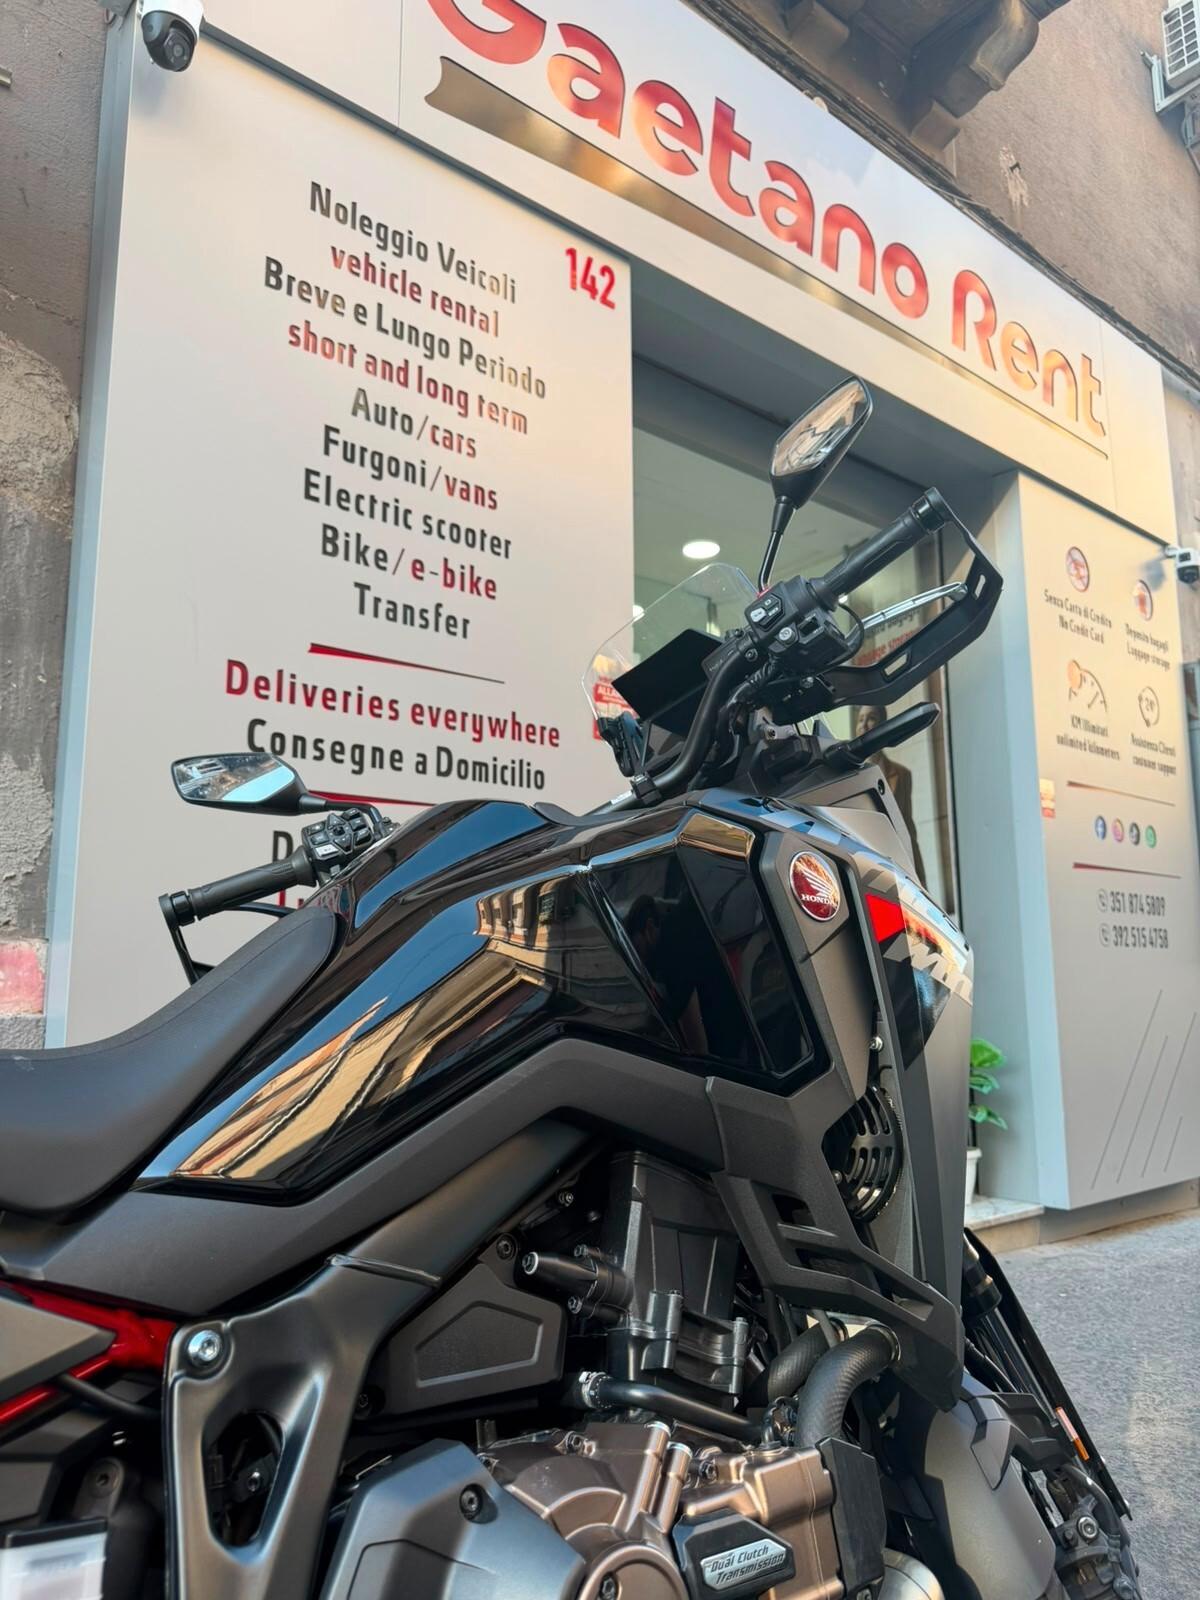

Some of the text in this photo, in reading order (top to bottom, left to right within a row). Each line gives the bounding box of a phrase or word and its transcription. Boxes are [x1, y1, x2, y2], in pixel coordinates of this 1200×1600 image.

[309, 181, 517, 304] Noleggio Veicoli
[565, 247, 617, 310] 142
[264, 256, 546, 399] Breve e Lungo Periodo
[331, 246, 499, 337] vehicle rental
[288, 320, 528, 434] short and long term
[951, 269, 1107, 438] Rent
[351, 387, 477, 459] Auto/cars
[323, 424, 498, 511] Furgoni/vans
[303, 468, 511, 560] Electric scooter
[354, 581, 470, 639] Transfer
[410, 557, 498, 600] e-bike
[225, 659, 561, 748] Deliveries everywhere
[247, 718, 546, 790] Consegne a Domicilio
[801, 893, 836, 908] HONDA
[1112, 925, 1129, 947] 392
[1131, 926, 1147, 948] 515
[711, 1545, 769, 1573] Dual Clutch
[716, 1553, 785, 1585] Transmission
